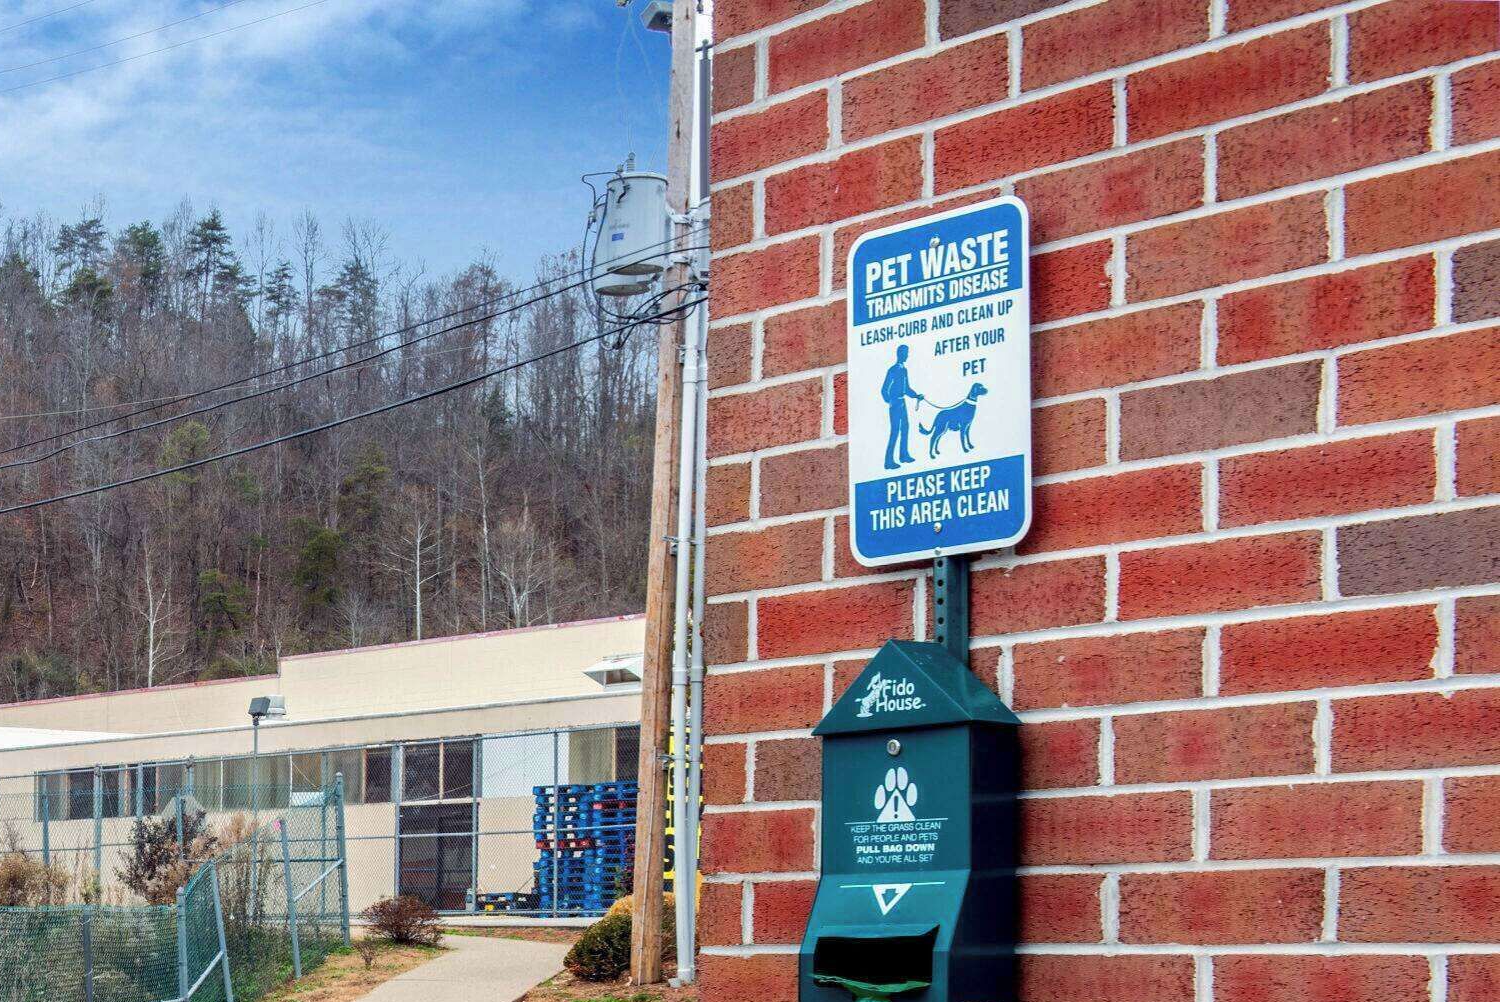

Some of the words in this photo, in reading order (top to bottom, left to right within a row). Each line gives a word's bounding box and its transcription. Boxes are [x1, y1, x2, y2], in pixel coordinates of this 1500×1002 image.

[865, 252, 912, 294] PET
[920, 229, 1009, 280] WASTE
[866, 283, 945, 319] TRANSMITS
[950, 267, 1009, 300] DISEASE
[860, 319, 927, 347] LEASH-CURB
[931, 312, 954, 331] AND
[957, 303, 994, 324] CLEAN
[997, 299, 1014, 316] UP
[934, 338, 970, 356] AFTER
[974, 327, 1005, 347] YOUR
[962, 358, 987, 377] PET
[886, 473, 945, 503] PLEASE
[950, 465, 991, 493] KEEP
[870, 505, 906, 531] THIS
[910, 498, 952, 525] AREA
[957, 488, 1010, 518] CLEAN
[882, 677, 915, 697] Fido
[875, 696, 922, 712] House
[851, 824, 871, 833] KEEP
[872, 824, 887, 833] THE
[887, 822, 914, 832] GRASS
[915, 821, 941, 831] CLEAN
[853, 835, 869, 844] FOR
[870, 834, 900, 843] PEOPLE
[900, 833, 917, 842] AND
[918, 832, 939, 841] PETS
[856, 845, 880, 854] PULL
[882, 844, 903, 853] BAG
[905, 843, 935, 852] DOWN
[857, 855, 874, 864] AND
[875, 855, 903, 863] YOU'RE
[903, 854, 918, 863] ALL
[918, 853, 934, 862] SET
